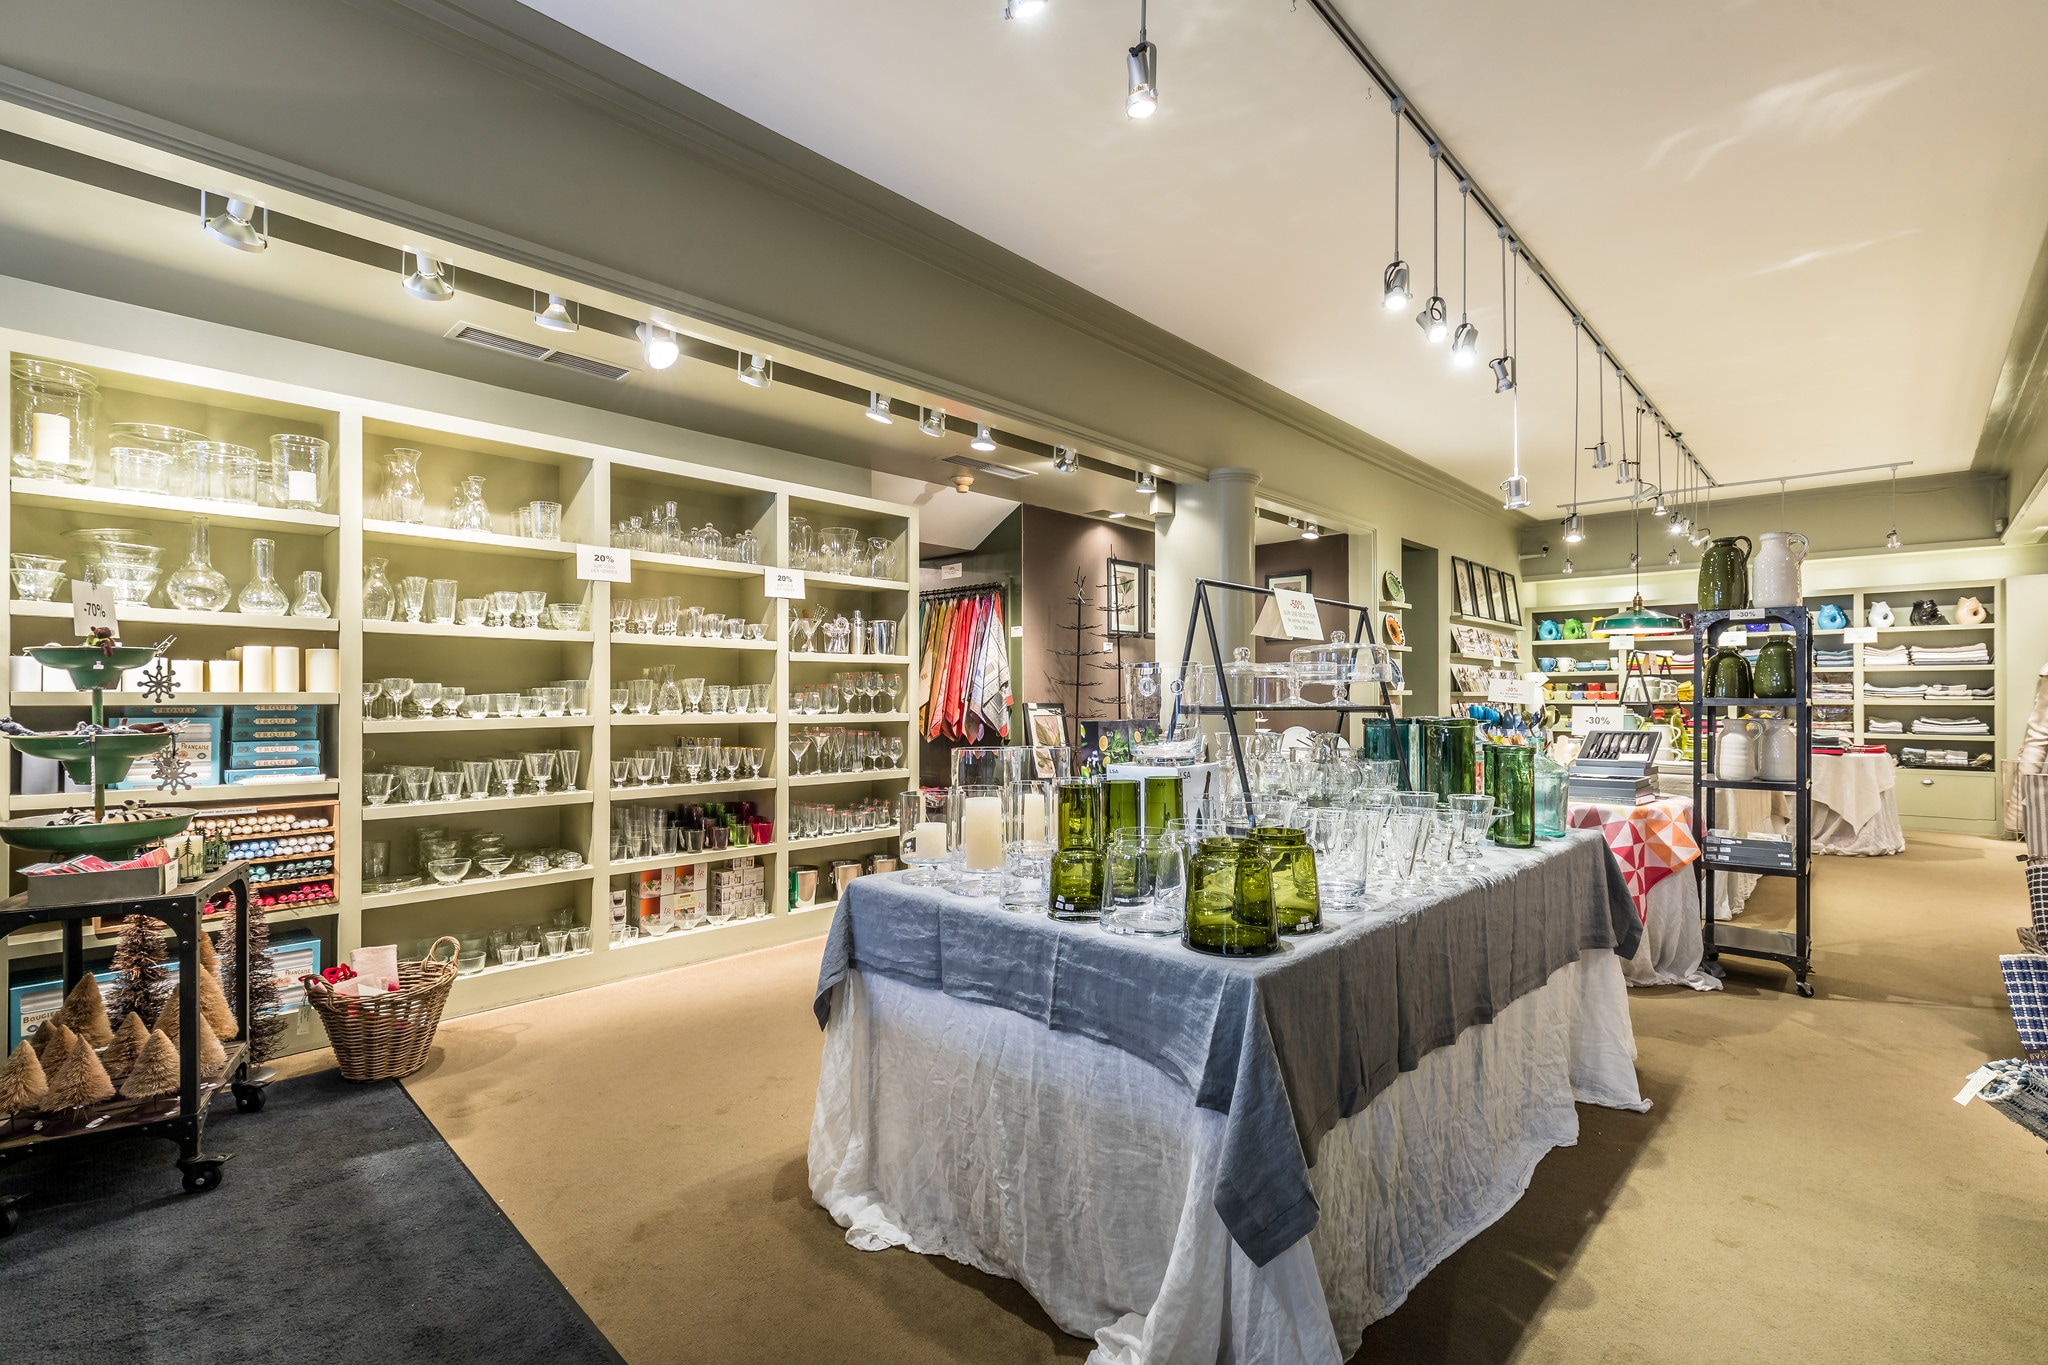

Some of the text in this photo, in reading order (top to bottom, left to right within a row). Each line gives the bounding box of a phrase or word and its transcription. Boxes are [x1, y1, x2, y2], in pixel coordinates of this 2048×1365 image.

[593, 554, 615, 563] 20%
[777, 574, 793, 583] 20%
[84, 602, 106, 618] -70%
[1585, 716, 1611, 725] -30%
